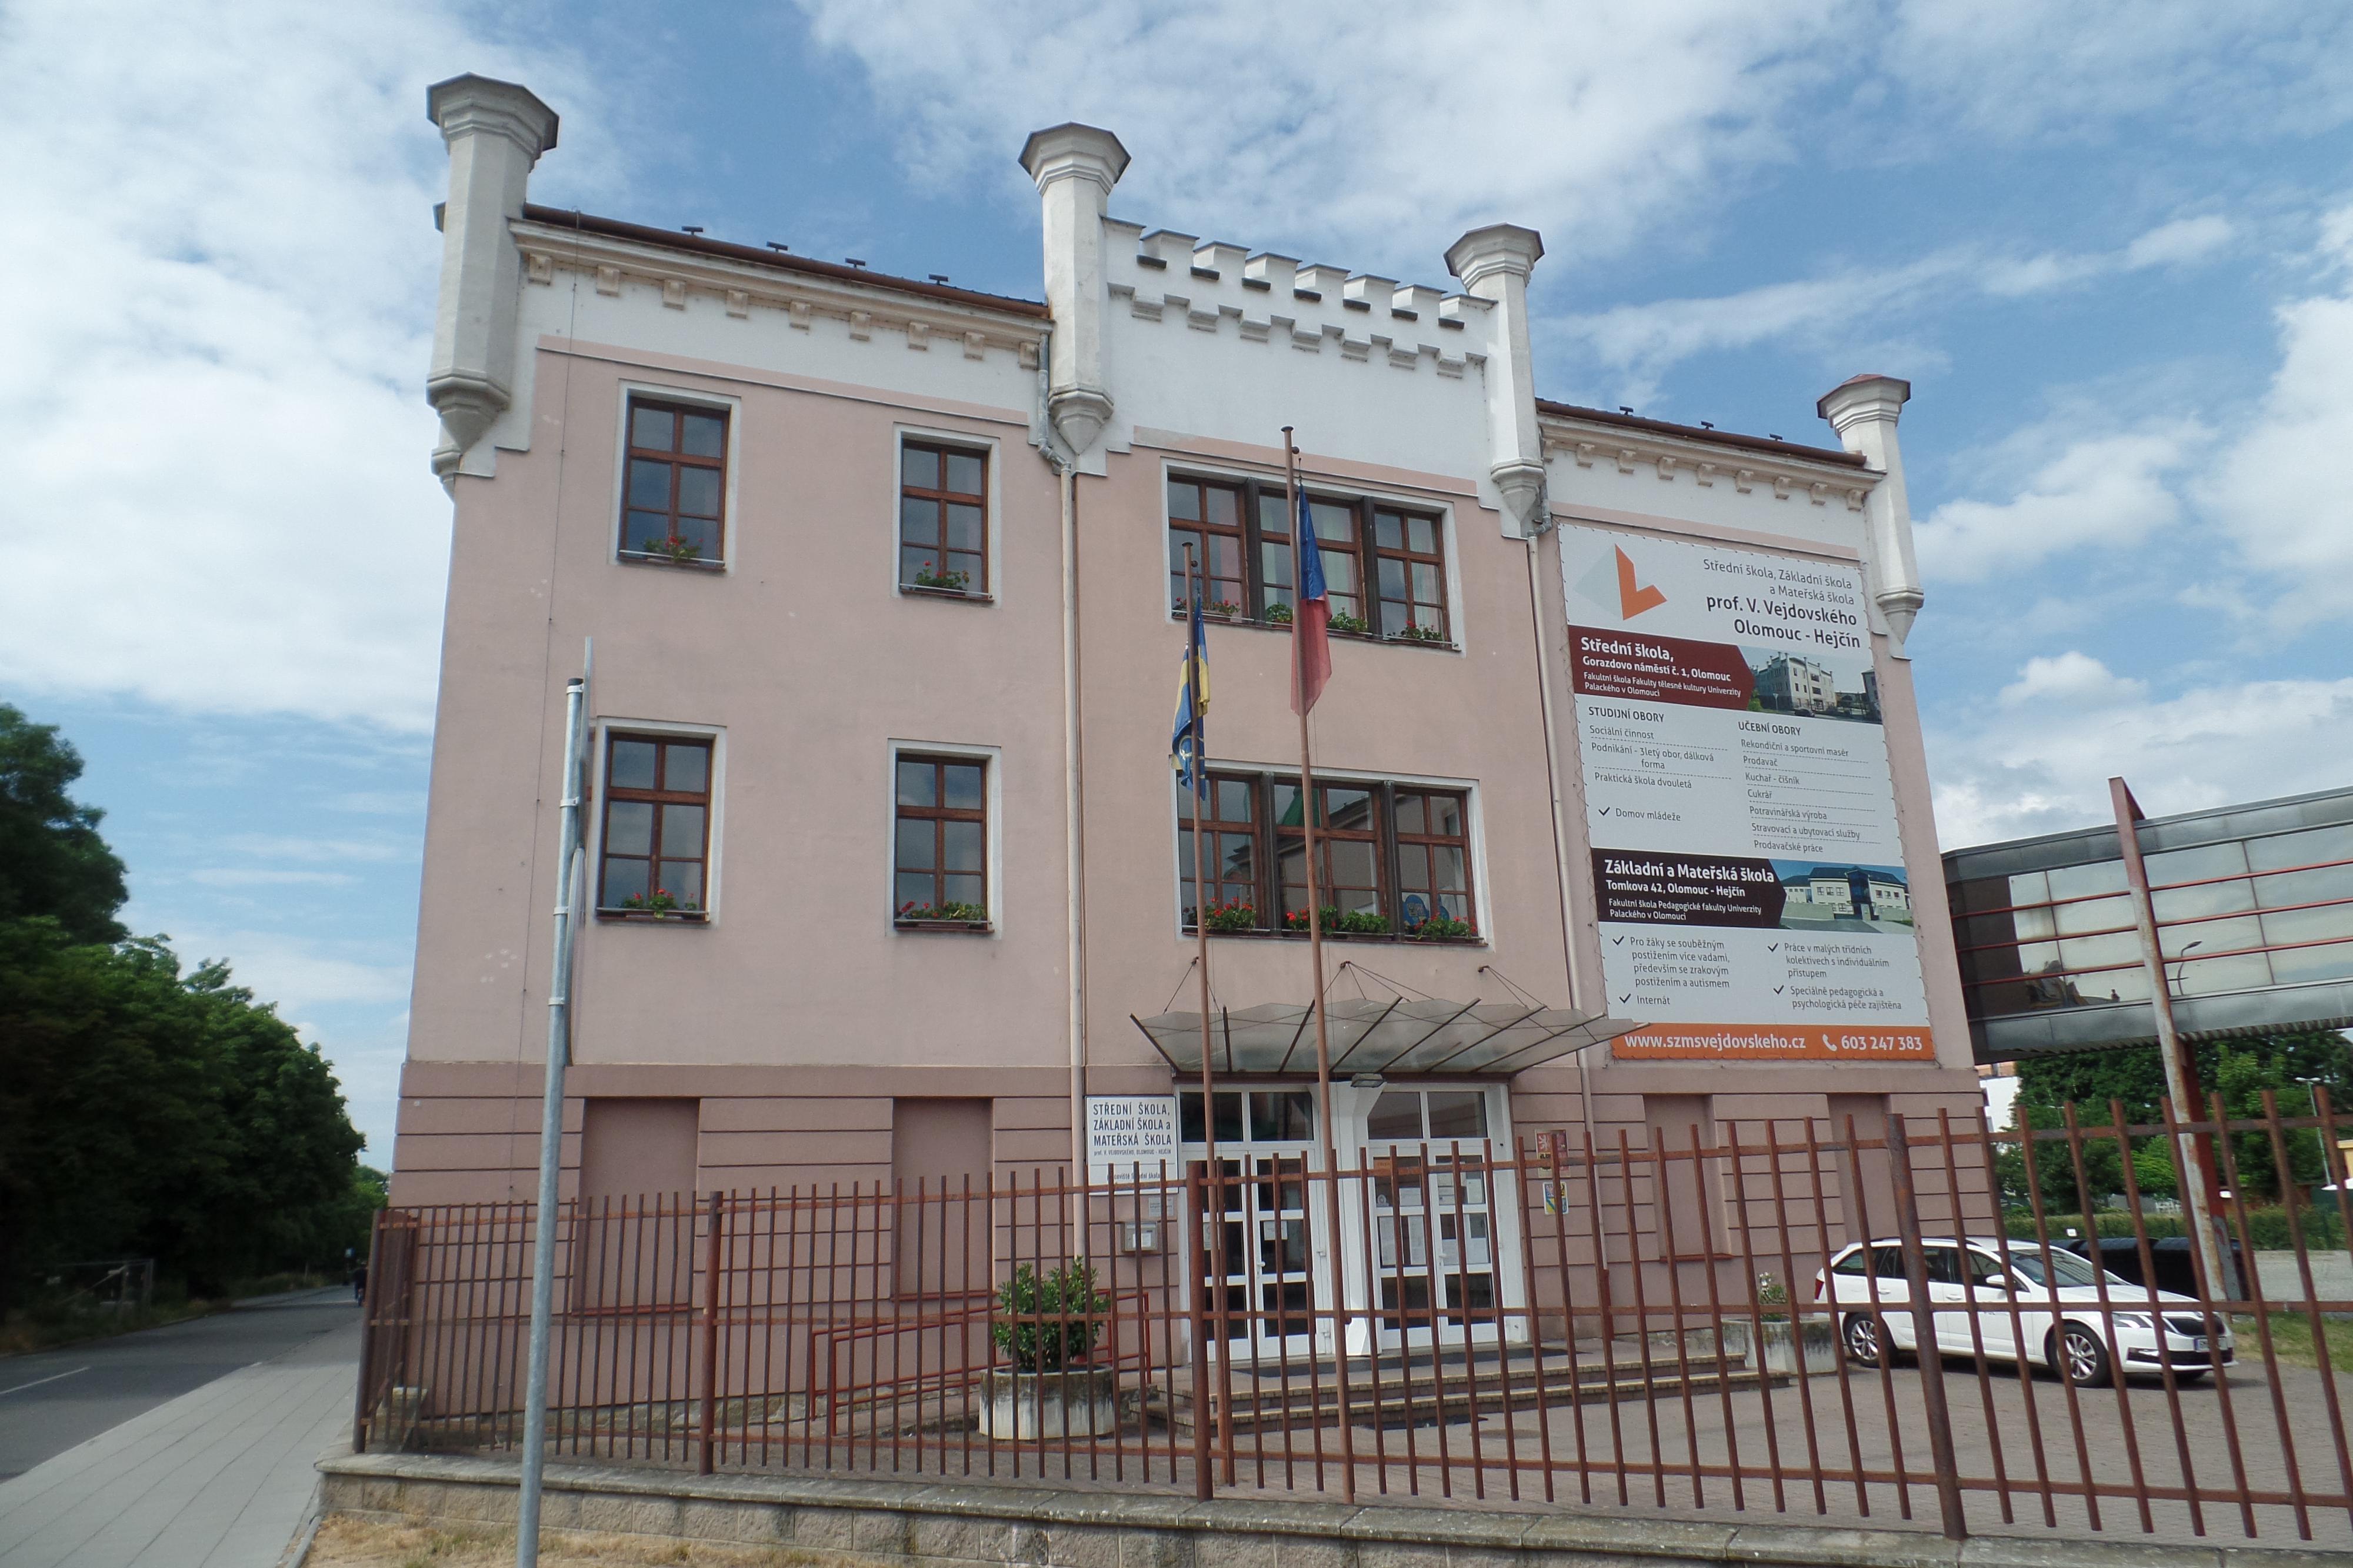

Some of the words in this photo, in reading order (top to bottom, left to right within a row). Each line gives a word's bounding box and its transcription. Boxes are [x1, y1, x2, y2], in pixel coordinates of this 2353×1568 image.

[1703, 559, 1743, 574] Střední
[1746, 565, 1776, 580] škola,
[1779, 569, 1822, 585] Základní
[1825, 576, 1852, 589] škola
[1778, 585, 1824, 600] Mateřská
[1828, 592, 1854, 605] škola
[1707, 596, 1743, 611] prof.
[1747, 598, 1760, 613] V.
[1763, 600, 1857, 625] Vejdovského
[1734, 619, 1802, 640] Olomouc
[1814, 629, 1860, 648] Hejčín
[1581, 637, 1631, 656] Střední
[1635, 643, 1674, 662] škola,
[1582, 656, 1632, 670] Gorazdovo
[1634, 663, 1670, 675] náměstí
[1672, 666, 1679, 675] č.
[1681, 669, 1689, 678] 1,
[1691, 669, 1731, 682] Olomouc
[1584, 672, 1612, 682] Fakultní
[1613, 675, 1631, 683] škola
[1632, 677, 1657, 688] Fakulty
[1658, 680, 1682, 689] tělesné
[1683, 683, 1707, 694] kultury
[1708, 686, 1741, 698] Univerzity
[1585, 682, 1619, 692] Palackého
[1628, 686, 1660, 696] Olomouci
[1588, 706, 1631, 719] STUDIJNÍ
[1633, 711, 1664, 722] OBORY
[1589, 725, 1622, 736] Sociální
[1625, 729, 1654, 739] činnost
[1738, 720, 1769, 733] UČEBNÍ
[1772, 725, 1801, 736] OBORY
[1591, 742, 1632, 753] Podnikání
[1640, 748, 1660, 759] 3letý
[1662, 750, 1682, 760] obor,
[1684, 752, 1714, 761] dálková
[1741, 739, 1782, 749] Rekondiční
[1791, 745, 1825, 755] sportovní
[1642, 759, 1665, 769] forma
[1744, 756, 1778, 766] Prodavač
[1595, 772, 1632, 783] Praktická
[1635, 776, 1655, 785] škola
[1658, 778, 1692, 788] dvouletá
[1745, 772, 1771, 782] Kuchař
[1748, 789, 1772, 799] Cukrář
[1615, 808, 1645, 818] Domov
[1647, 812, 1681, 821] mládeže
[1750, 806, 1800, 818] Potravinářská
[1802, 811, 1827, 821] výroba
[1752, 823, 1791, 833] Stravovací
[1799, 827, 1834, 837] ubytovací
[1837, 829, 1860, 840] služby
[1754, 840, 1801, 851] Prodavačské
[1804, 845, 1823, 853] práce
[1605, 859, 1664, 876] Základní
[1667, 866, 1674, 878] a
[1678, 863, 1738, 881] Mateřská
[1741, 868, 1774, 882] škola
[1606, 880, 1648, 892] Tomkova
[1651, 883, 1666, 894] 42,
[1667, 883, 1708, 895] Olomouc
[1717, 886, 1745, 898] Hejčín
[1609, 898, 1637, 907] Fakultní
[1659, 901, 1701, 911] Pedagogické
[1702, 903, 1726, 913] fakulty
[1727, 905, 1761, 915] Univerzity
[1610, 909, 1646, 919] Palackého
[1630, 937, 1644, 946] Pro
[1647, 938, 1664, 949] žáky
[1678, 939, 1724, 951] souběžným
[1785, 943, 1805, 952] Práce
[1814, 945, 1840, 955] malých
[1632, 951, 1677, 961] postižením
[1679, 952, 1695, 960] více
[1698, 953, 1729, 963] vadami,
[1787, 955, 1829, 965] kolektivech
[1837, 958, 1889, 967] individuálním
[1634, 964, 1677, 974] především
[1690, 966, 1729, 977] zrakovým
[1635, 977, 1681, 987] postižením
[1791, 986, 1827, 997] Speciálně
[1829, 987, 1877, 998] pedagogická
[1637, 995, 1671, 1005] Internát
[1793, 999, 1846, 1010] psychologická
[1848, 1001, 1866, 1010] péče
[1624, 1033, 1806, 1051] www.szmsvejdovskeho.cz
[1841, 1036, 1867, 1050] 603
[1869, 1036, 1894, 1050] 247
[1898, 1036, 1922, 1050] 383
[1093, 1102, 1132, 1116] STŘEDNÍ
[1138, 1102, 1170, 1116] ŠKOLA,
[1094, 1117, 1135, 1131] ZÁKLADNÍ
[1138, 1117, 1164, 1130] ŠKOLA
[1094, 1133, 1139, 1146] MATEŘSKÁ
[1145, 1134, 1171, 1145] ŠKOLA
